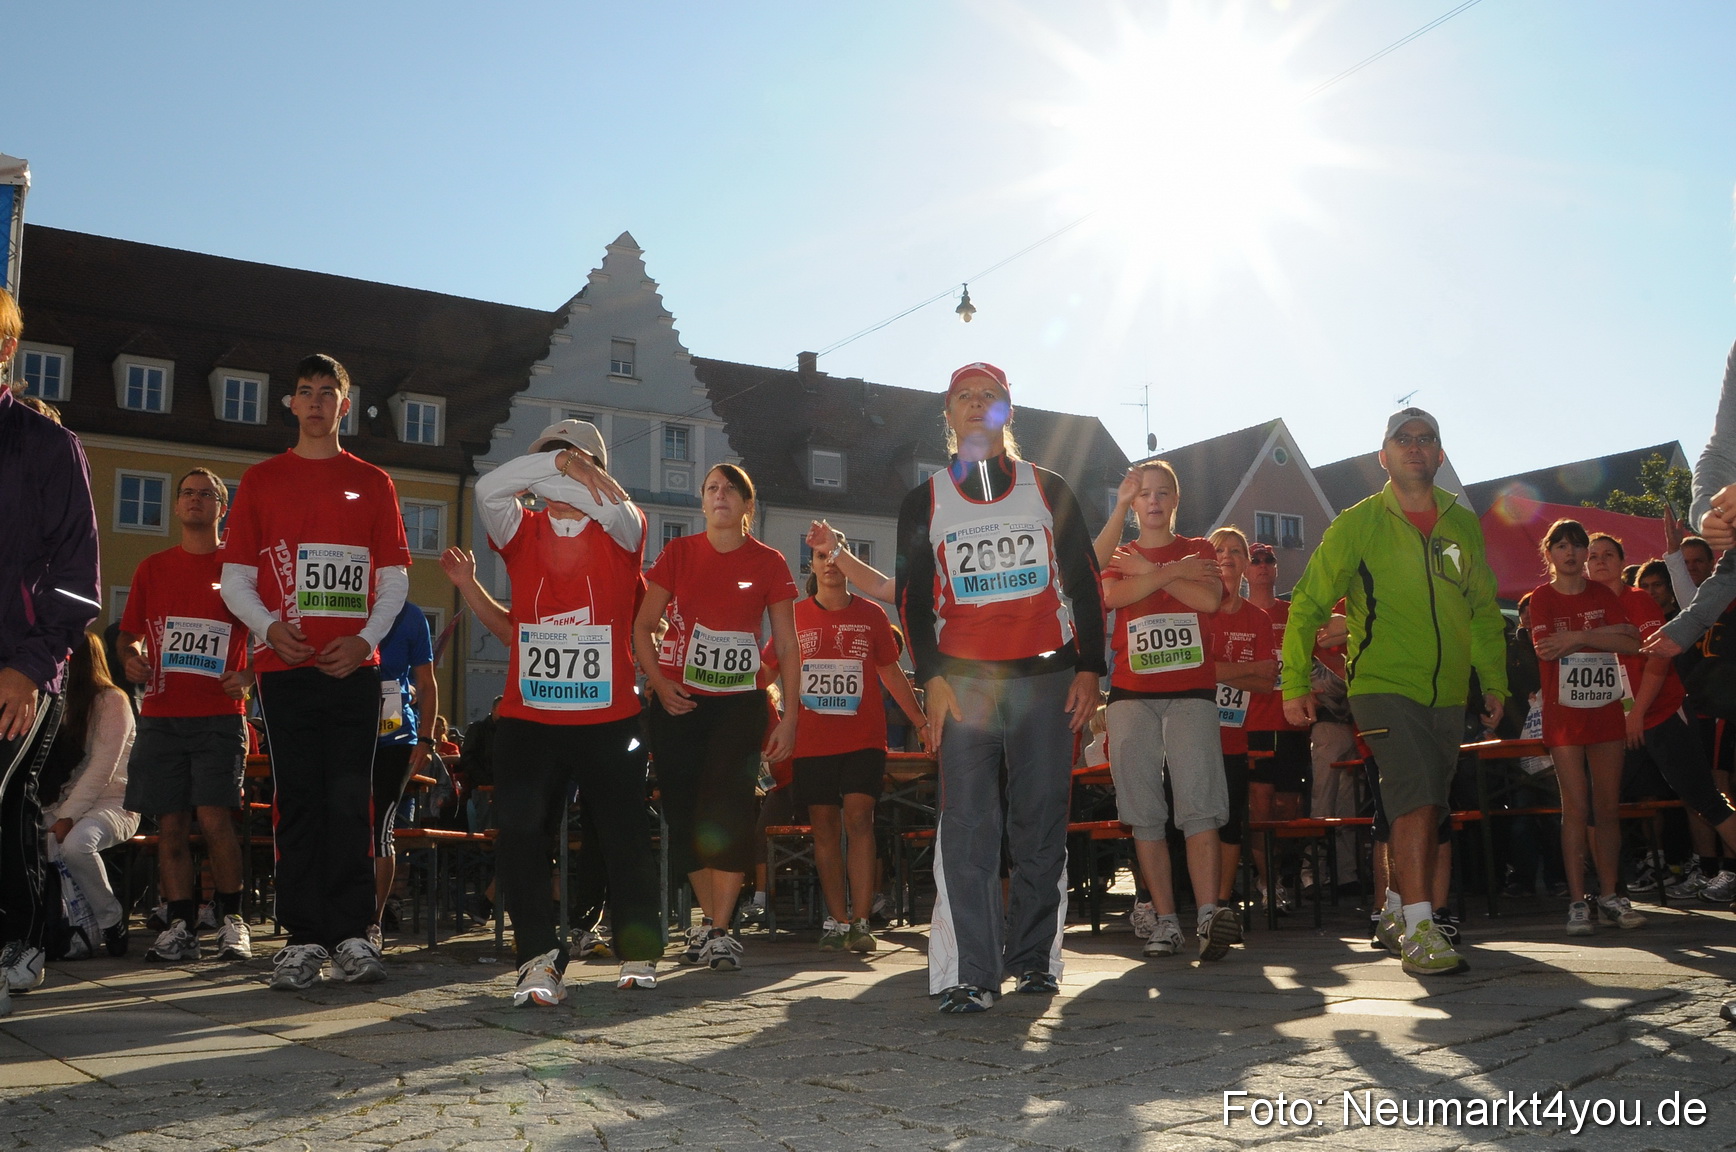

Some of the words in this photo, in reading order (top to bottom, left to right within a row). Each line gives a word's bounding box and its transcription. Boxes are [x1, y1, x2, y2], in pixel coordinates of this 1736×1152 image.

[958, 524, 1000, 536] PFLEIDERER
[309, 549, 344, 558] PFLEIDERER
[957, 534, 1036, 573] 2692
[306, 563, 363, 591] 5048
[964, 571, 1037, 593] Marliese
[304, 592, 362, 608] Johannes
[175, 621, 203, 629] PFLEIDERER
[1137, 618, 1166, 628] PFLEIDERER
[169, 631, 220, 656] 2041
[530, 632, 568, 641] PFLEIDERER
[700, 631, 731, 643] PFLEIDERER
[1136, 628, 1192, 652] 5099
[169, 653, 217, 669] Matthias
[528, 647, 600, 679] 2978
[694, 643, 752, 671] 5188
[1141, 649, 1191, 666] Stefanie
[695, 668, 744, 685] Melanie
[807, 673, 857, 694] 2566
[1566, 667, 1615, 688] 4046
[530, 681, 598, 698] Veronika
[1218, 686, 1243, 708] 34
[1570, 689, 1612, 700] Barbara
[817, 696, 846, 707] Talita
